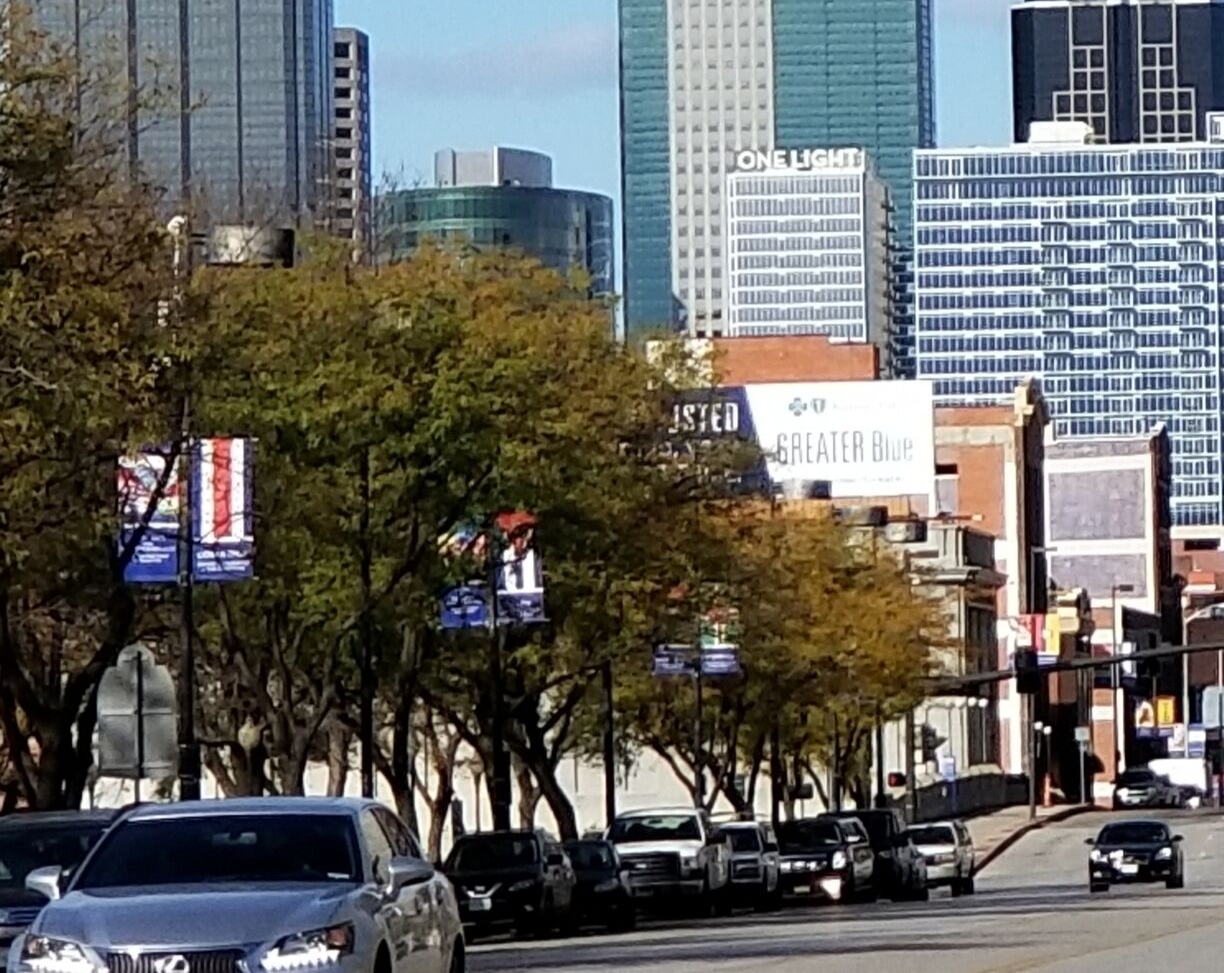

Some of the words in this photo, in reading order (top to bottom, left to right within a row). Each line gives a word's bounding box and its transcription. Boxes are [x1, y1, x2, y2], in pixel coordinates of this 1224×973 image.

[737, 149, 787, 170] ONE
[789, 147, 859, 170] LIGHT
[776, 430, 864, 466] GREATER
[872, 430, 914, 463] Blue
